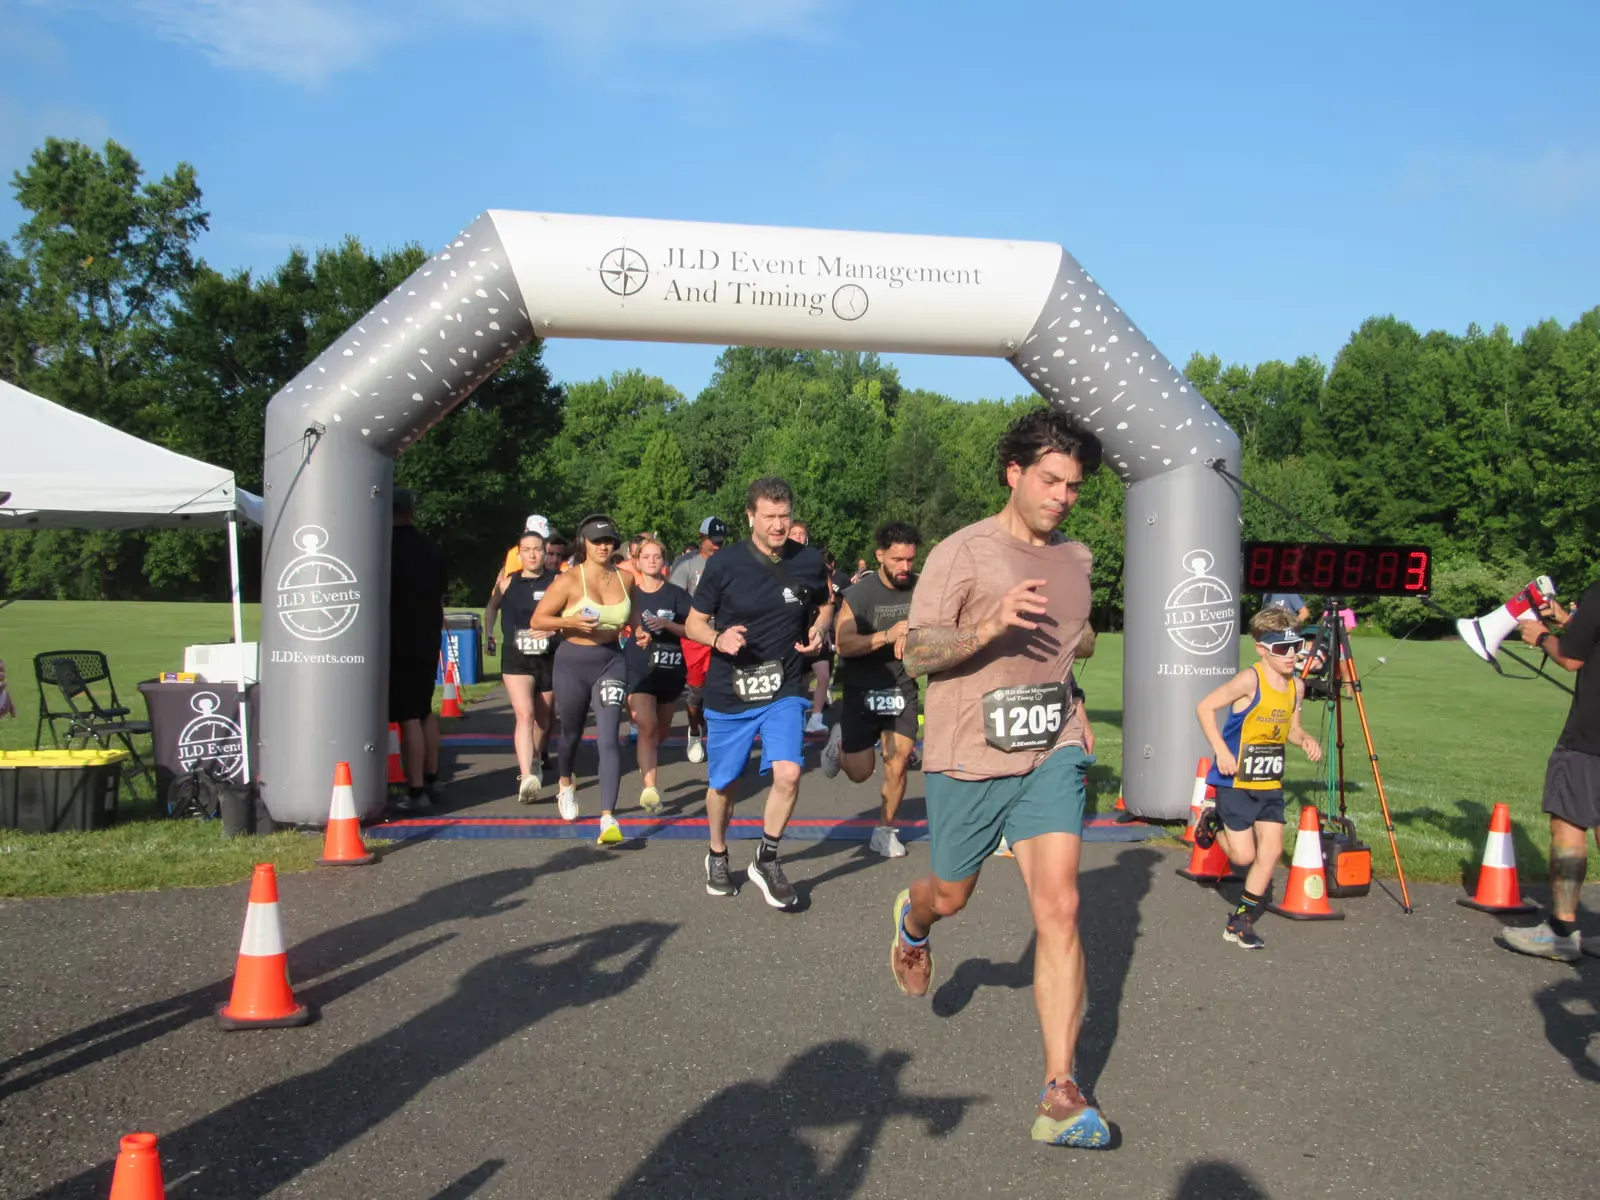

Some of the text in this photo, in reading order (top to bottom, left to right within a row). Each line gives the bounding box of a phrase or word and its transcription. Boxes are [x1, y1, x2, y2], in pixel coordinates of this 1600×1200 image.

[663, 247, 982, 289] JLD Event Management
[663, 279, 827, 317] And Timing
[276, 589, 361, 608] JLD Events
[1164, 607, 1235, 626] JLD Events
[515, 637, 548, 650] 1210
[271, 650, 365, 664] JLDEvents.com
[653, 651, 682, 665] 1212
[1157, 663, 1237, 676] JLDEvents.com
[735, 672, 781, 696] 1233
[600, 686, 626, 702] 127
[867, 695, 905, 711] 1290
[990, 703, 1062, 737] 1205
[178, 745, 204, 759] JLD
[1243, 756, 1283, 775] 1276
